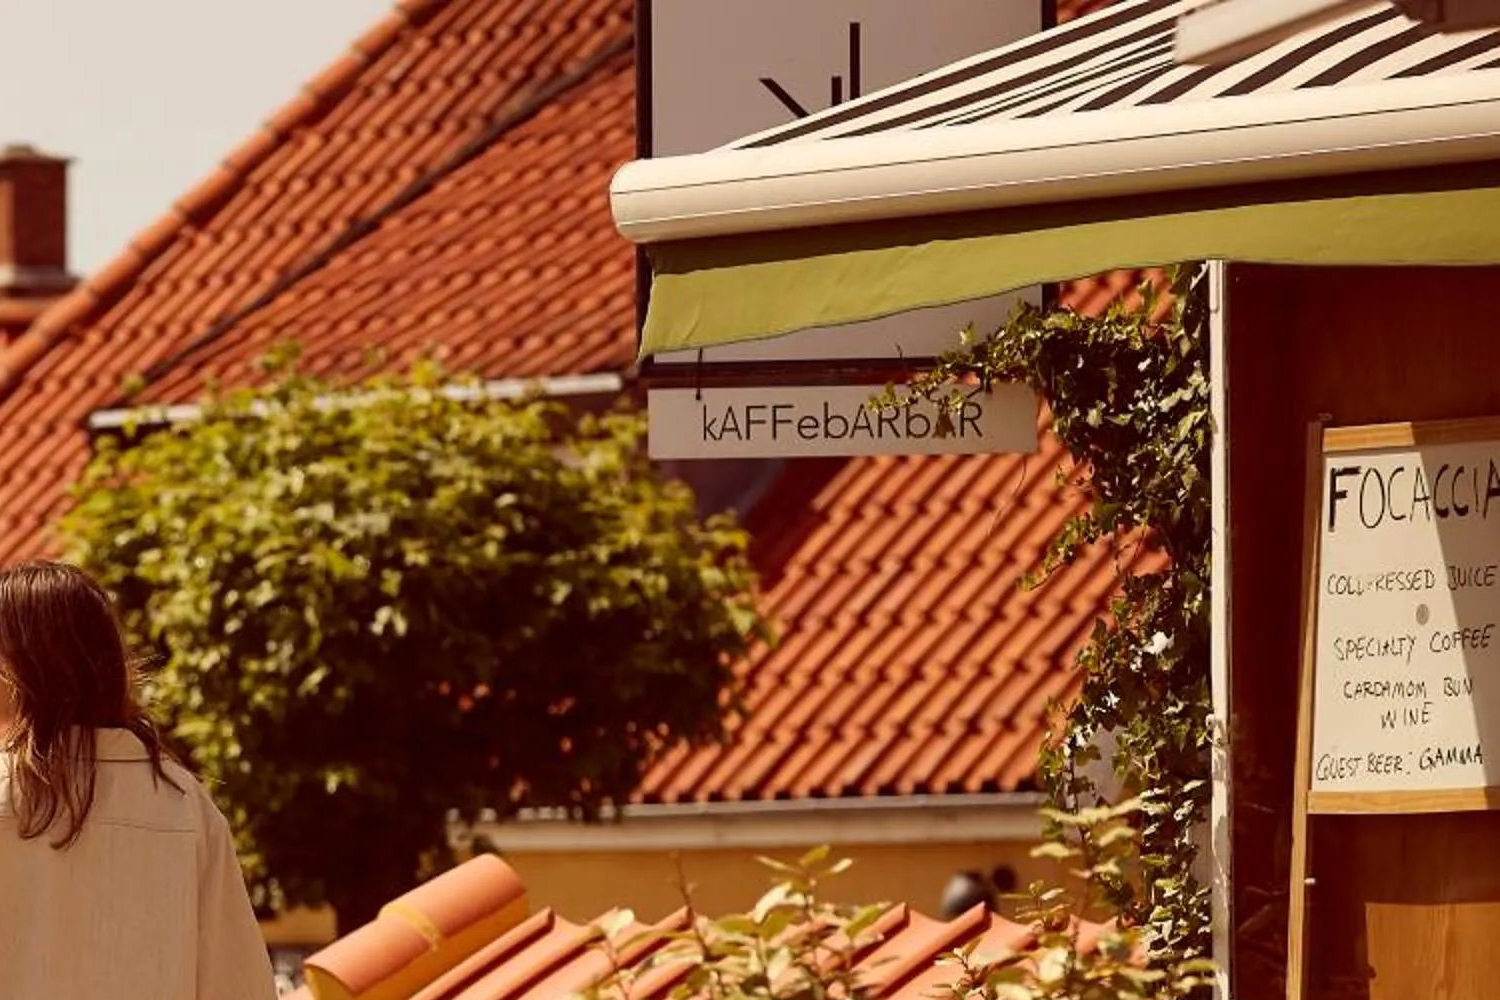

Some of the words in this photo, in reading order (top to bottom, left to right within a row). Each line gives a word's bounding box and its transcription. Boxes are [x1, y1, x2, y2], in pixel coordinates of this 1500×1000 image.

[1327, 458, 1500, 533] FOCACCIA
[1447, 565, 1498, 591] JUICE
[1333, 634, 1417, 666] SPECIALTY
[1429, 623, 1496, 653] COFFEE
[1343, 679, 1428, 700] CARDAMOM
[1443, 676, 1474, 698] BUN
[1380, 701, 1434, 730] WINE
[1315, 753, 1363, 781] GUEST
[1419, 744, 1484, 771] GAMMA
